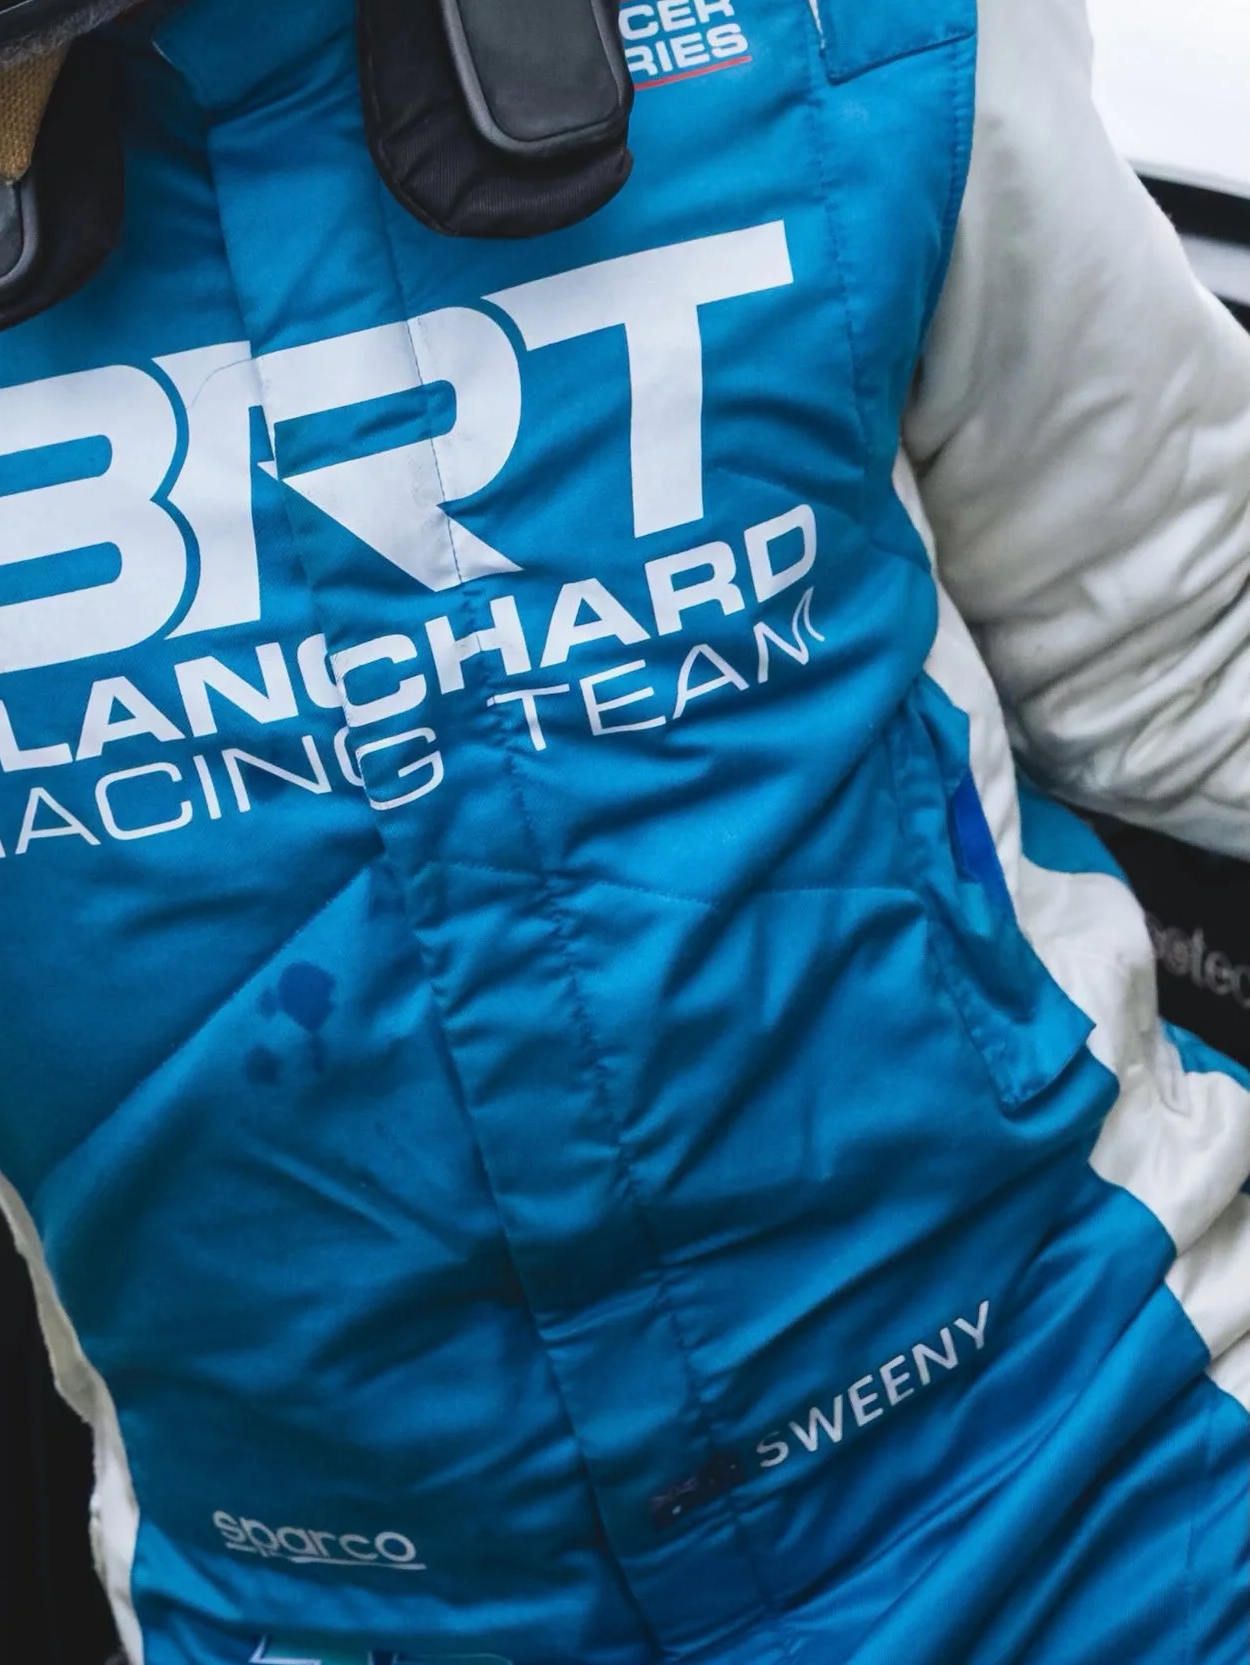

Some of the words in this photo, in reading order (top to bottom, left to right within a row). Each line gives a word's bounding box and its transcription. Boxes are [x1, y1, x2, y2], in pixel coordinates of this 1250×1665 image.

[623, 22, 749, 77] RIES
[487, 586, 826, 752] TEAM
[755, 1299, 990, 1468] SWEENY
[212, 1509, 427, 1571] sparco
